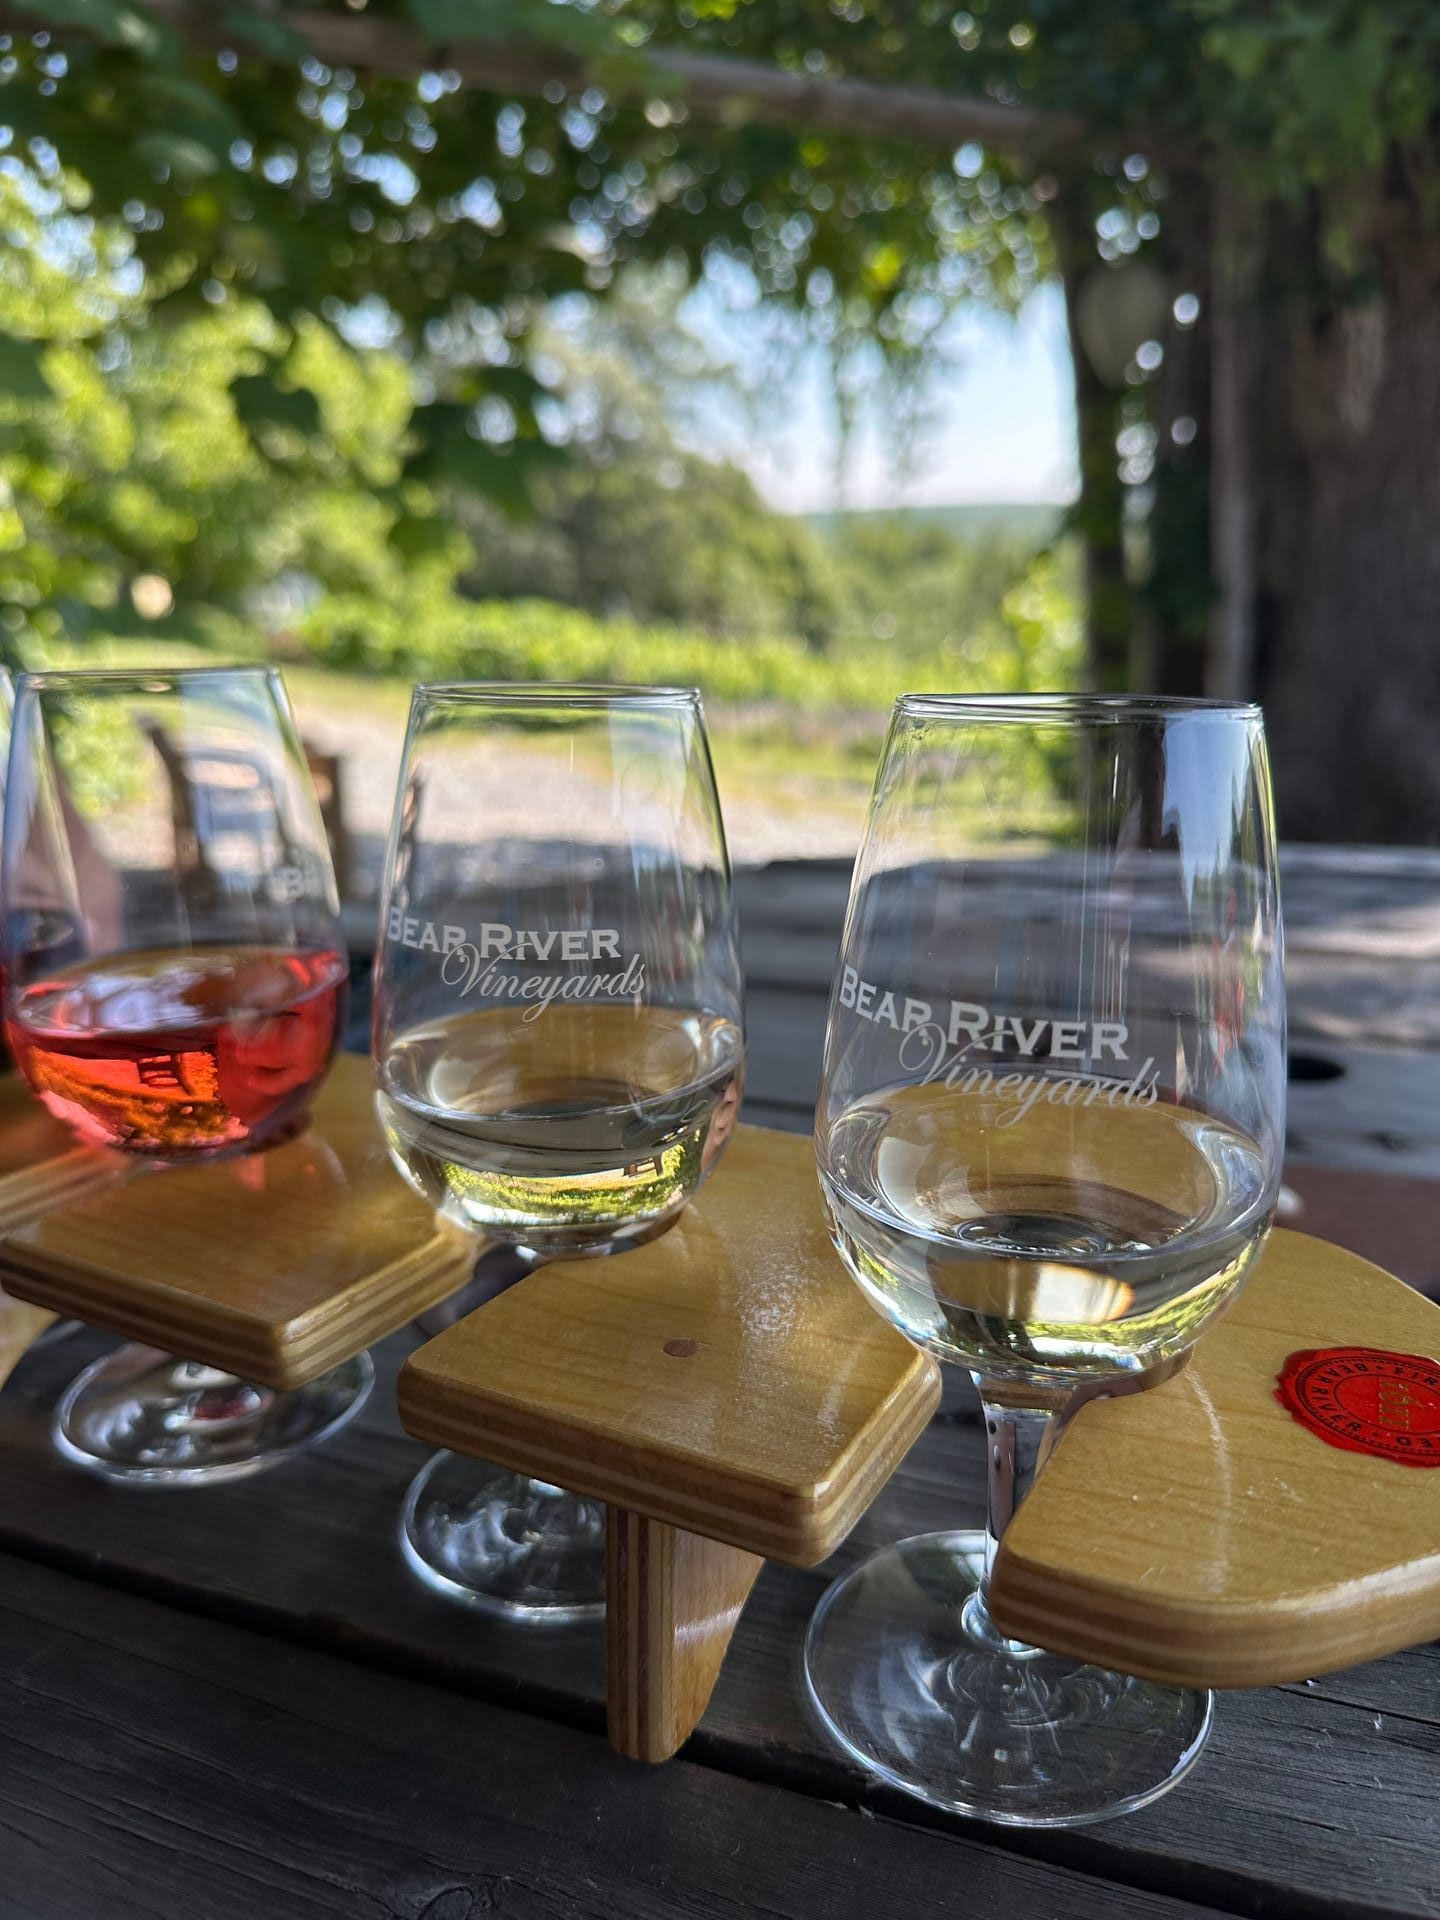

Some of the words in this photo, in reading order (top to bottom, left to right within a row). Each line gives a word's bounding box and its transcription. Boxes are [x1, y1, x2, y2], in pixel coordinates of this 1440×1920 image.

[387, 906, 467, 956] BEAR
[480, 922, 622, 961] RIVER
[441, 943, 645, 1023] Vineyards
[839, 964, 933, 1036] BEAR
[947, 1000, 1130, 1061] RIVER
[899, 1022, 1161, 1129] Vineyards
